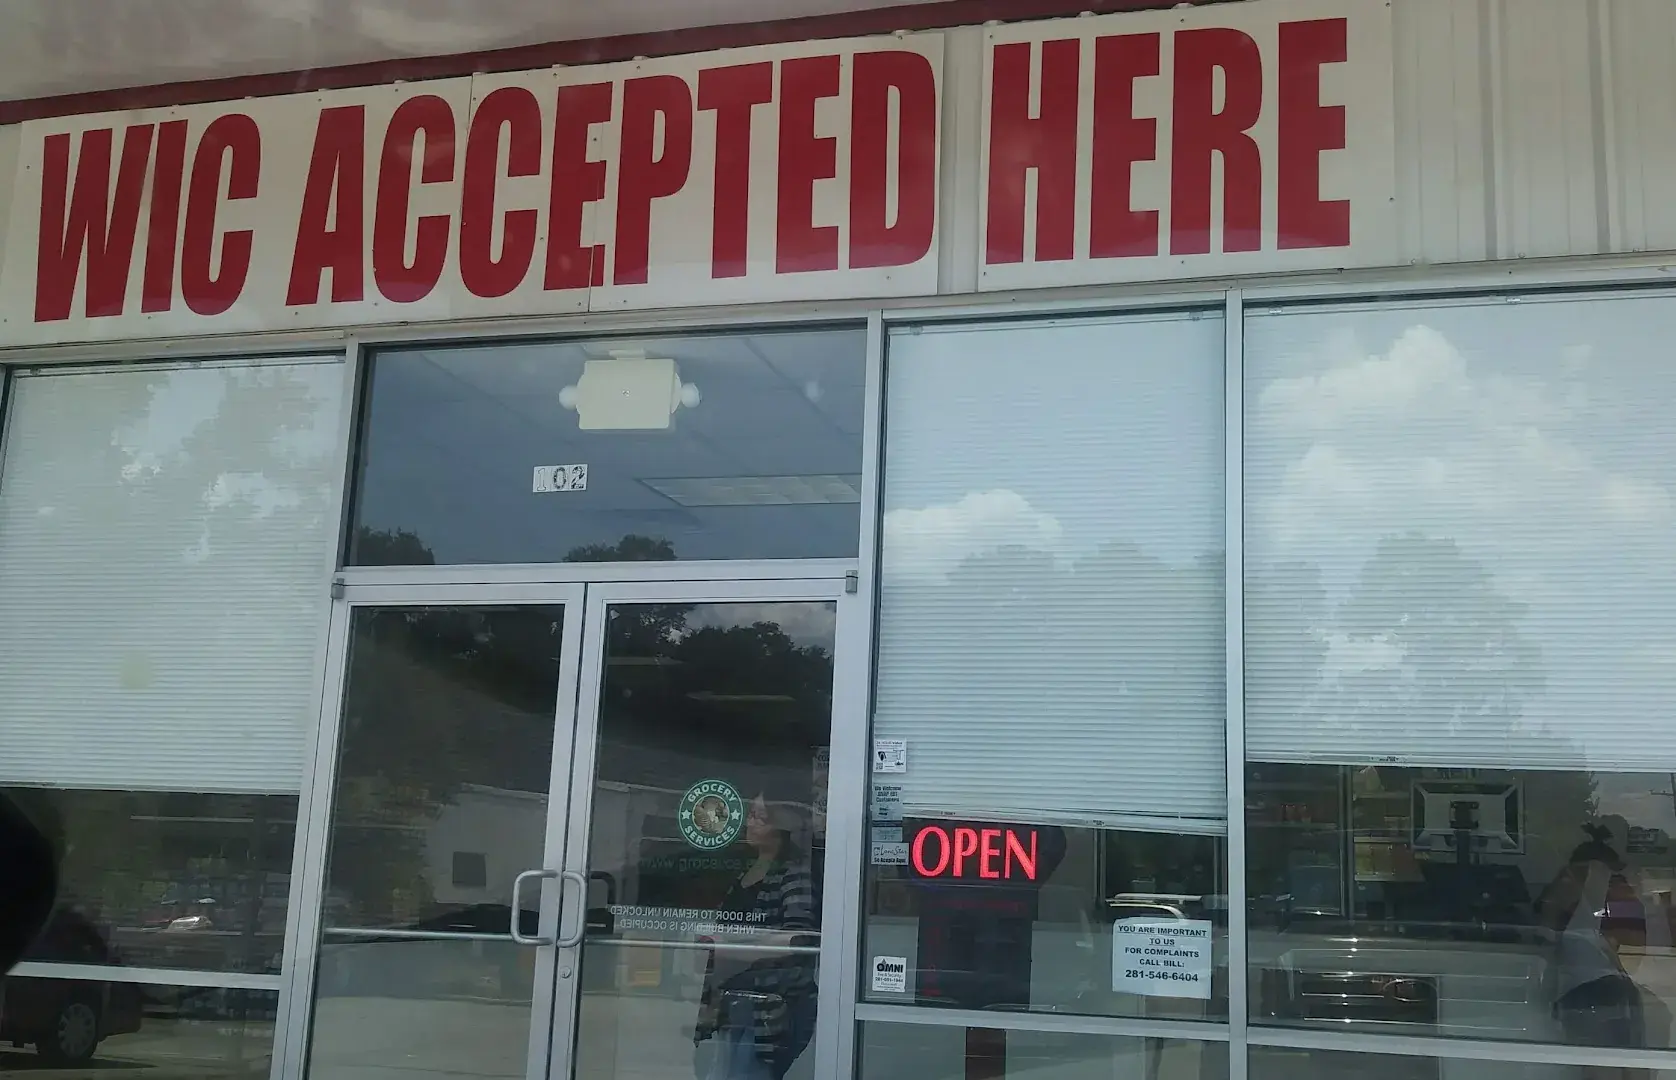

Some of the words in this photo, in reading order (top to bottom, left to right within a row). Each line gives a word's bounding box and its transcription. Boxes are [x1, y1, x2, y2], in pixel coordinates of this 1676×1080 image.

[34, 113, 261, 323] WIC
[285, 50, 936, 306] ACCEPTED
[986, 18, 1350, 265] HERE
[536, 466, 585, 492] 102
[687, 783, 737, 802] GROCERY
[684, 826, 735, 846] SERVICES
[912, 826, 1037, 880] OPEN
[1157, 928, 1207, 936] IMPORTANT
[1144, 948, 1199, 958] COMPLAINTS
[877, 963, 903, 972] OMNI
[1125, 970, 1198, 982] 281-546-6404
